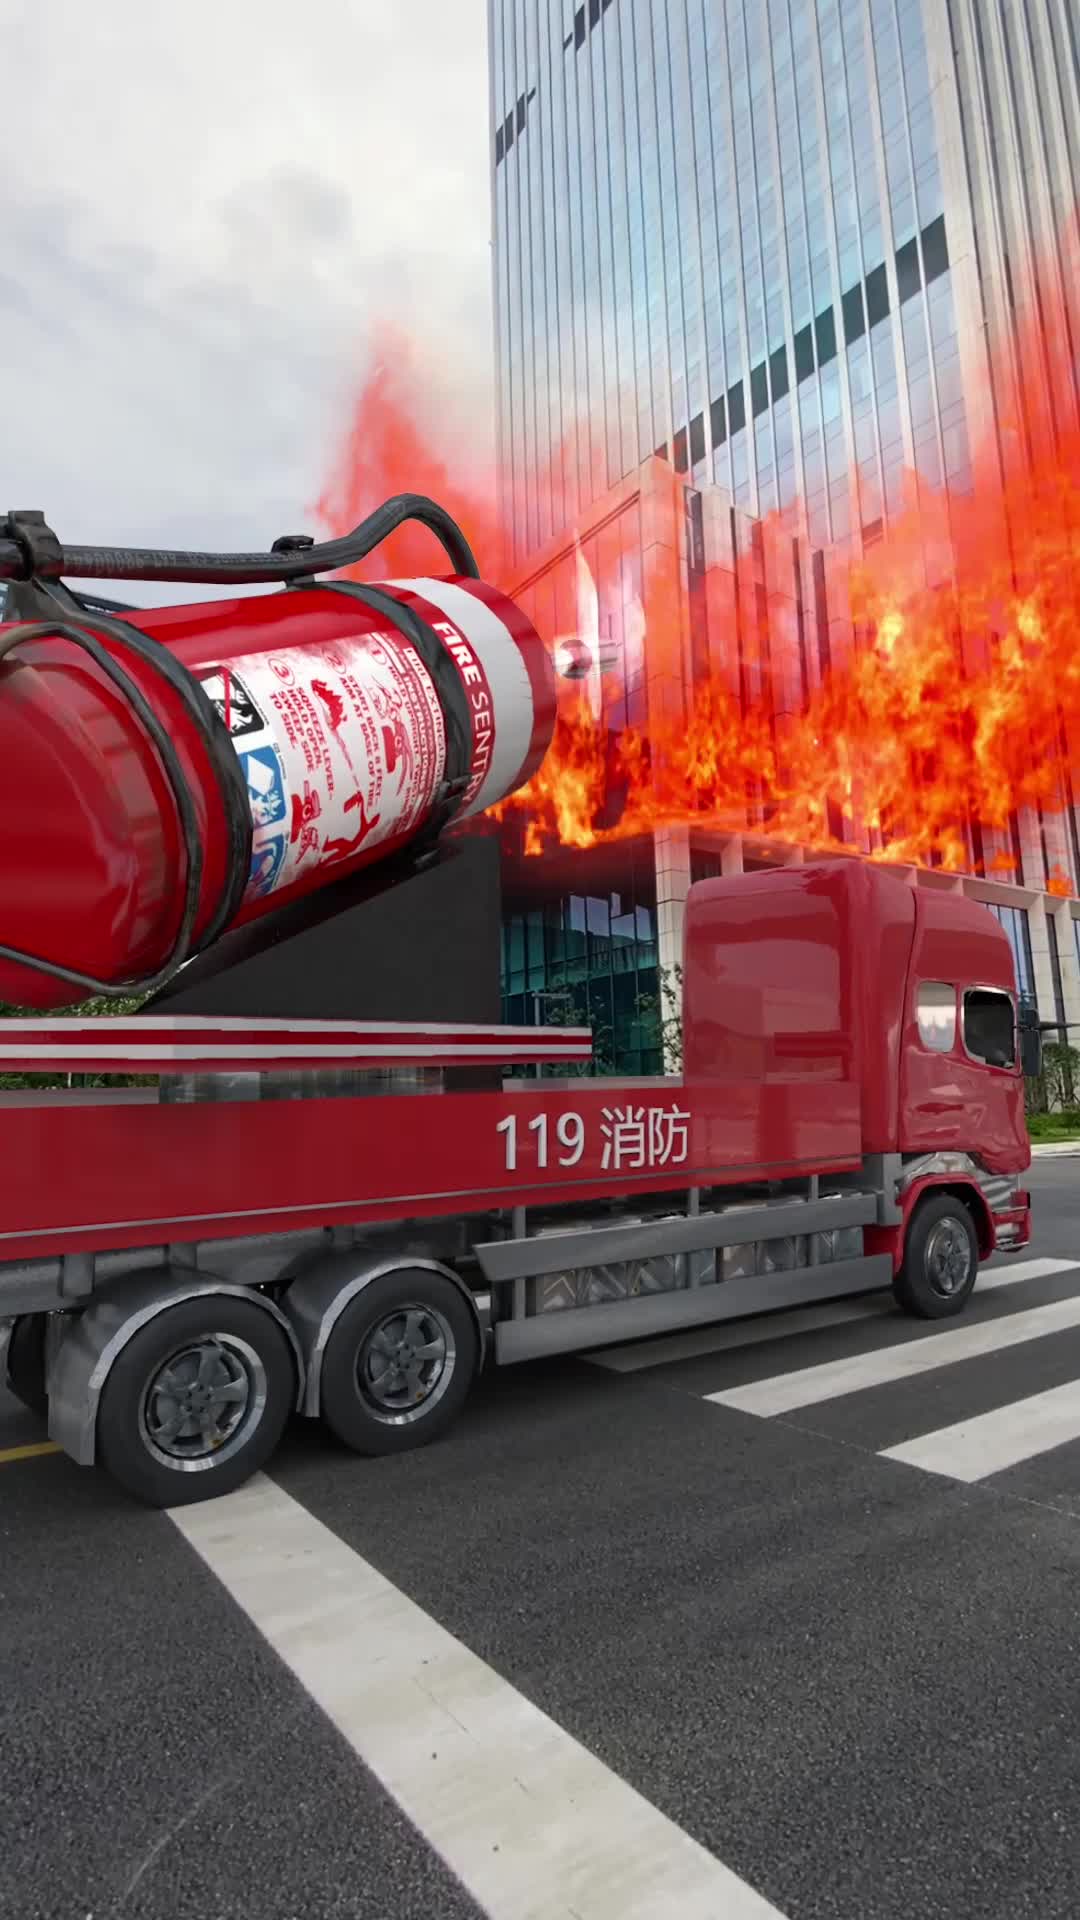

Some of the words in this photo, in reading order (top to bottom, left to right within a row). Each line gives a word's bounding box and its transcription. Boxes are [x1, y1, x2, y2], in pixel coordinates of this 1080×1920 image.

[388, 666, 407, 697] HOLD
[407, 650, 426, 677] FIRE
[270, 691, 283, 709] TO
[279, 690, 305, 736] SWEEP
[301, 740, 314, 773] SIDE
[287, 688, 310, 723] HOLD
[296, 687, 326, 745] SQUEEZE
[340, 676, 356, 699] AIM
[353, 704, 363, 718] AT
[360, 723, 373, 756] BASE
[368, 761, 376, 776] OF
[348, 675, 369, 712] START
[366, 716, 379, 751] BACK
[403, 676, 428, 790] INSTRUCTIONS
[432, 622, 482, 686] FIRE
[460, 691, 491, 803] SENTRY
[496, 1112, 585, 1170] 119
[600, 1104, 691, 1169] 消防
